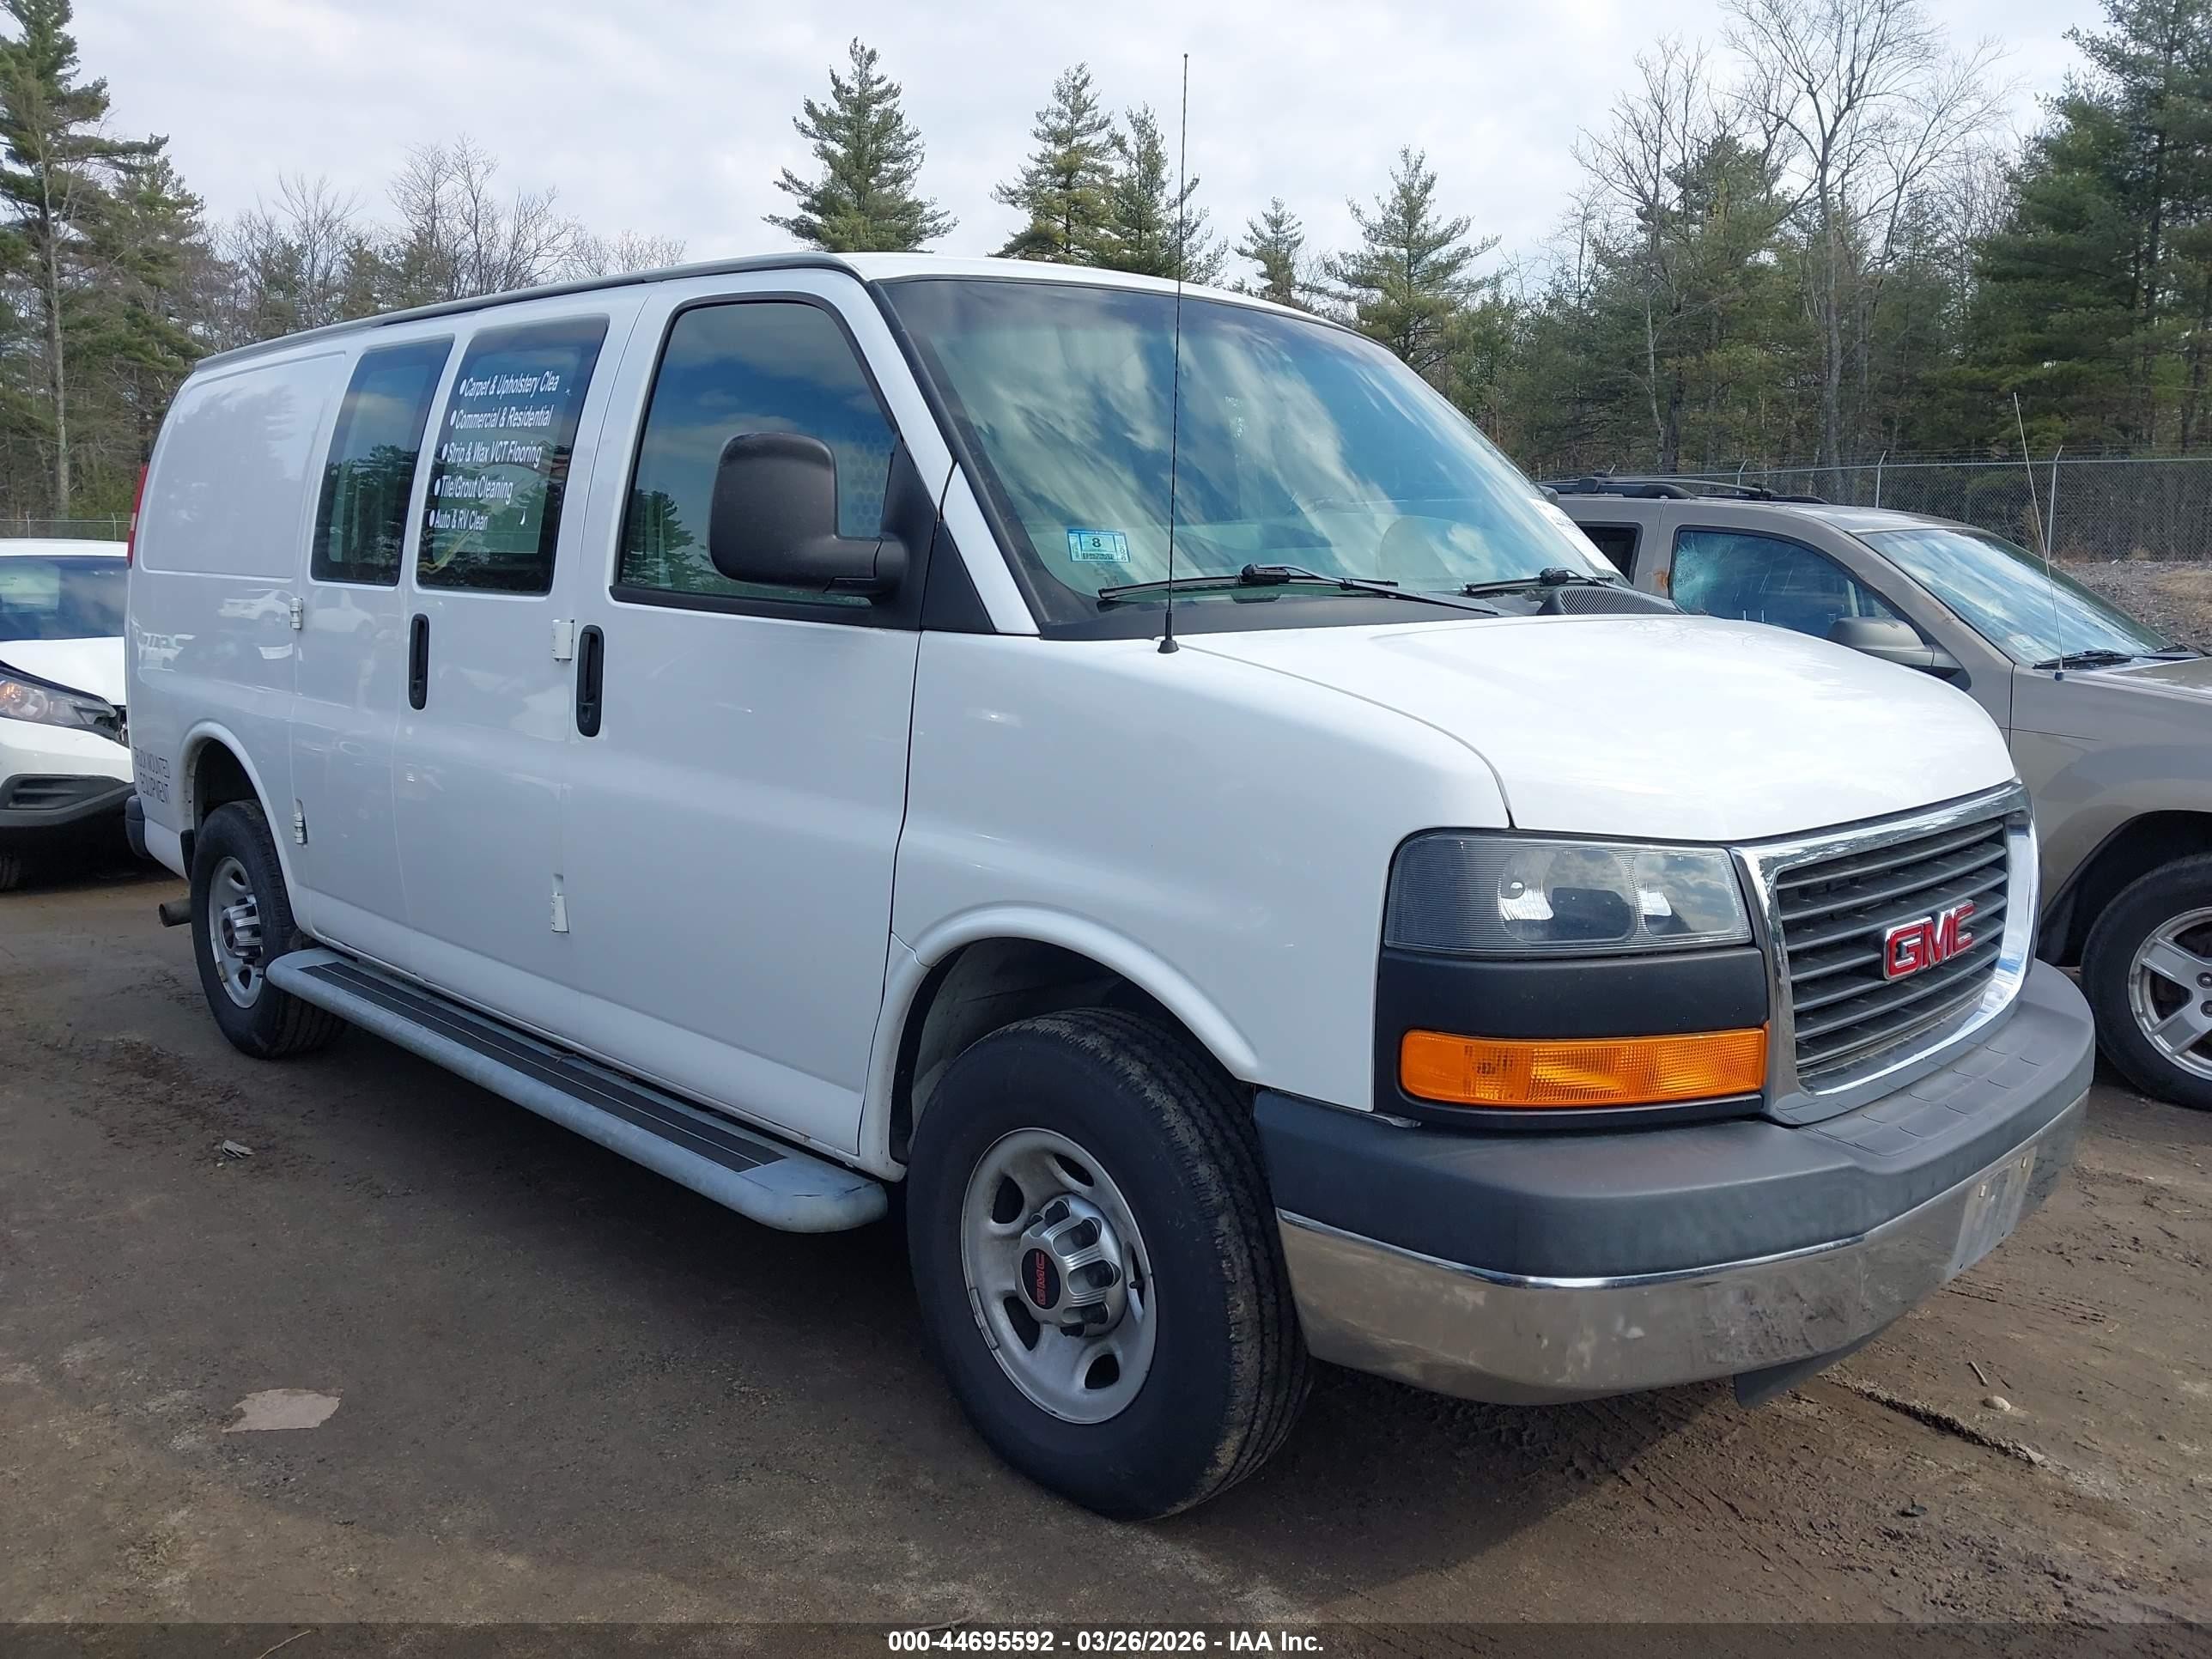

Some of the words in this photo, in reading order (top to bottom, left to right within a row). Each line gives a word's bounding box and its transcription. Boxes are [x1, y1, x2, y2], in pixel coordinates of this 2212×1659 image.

[465, 378, 489, 401] Carpet
[489, 376, 496, 392] &
[496, 373, 540, 398] Upholstery
[456, 407, 498, 429] Commercial
[499, 409, 507, 428] &
[507, 404, 553, 427] Residential
[447, 442, 465, 466] Strip
[465, 443, 472, 462] &
[473, 440, 489, 462] Wax
[490, 441, 507, 462] VCT
[507, 441, 543, 468] Flooring
[441, 476, 477, 498] Tile/Grout
[477, 477, 513, 505] Cleaning
[434, 512, 450, 527] Auto
[451, 512, 458, 529] &
[458, 512, 469, 529] RV
[1092, 538, 1102, 548] 8
[1883, 899, 1975, 981] GMC
[1036, 1251, 1046, 1306] GMC
